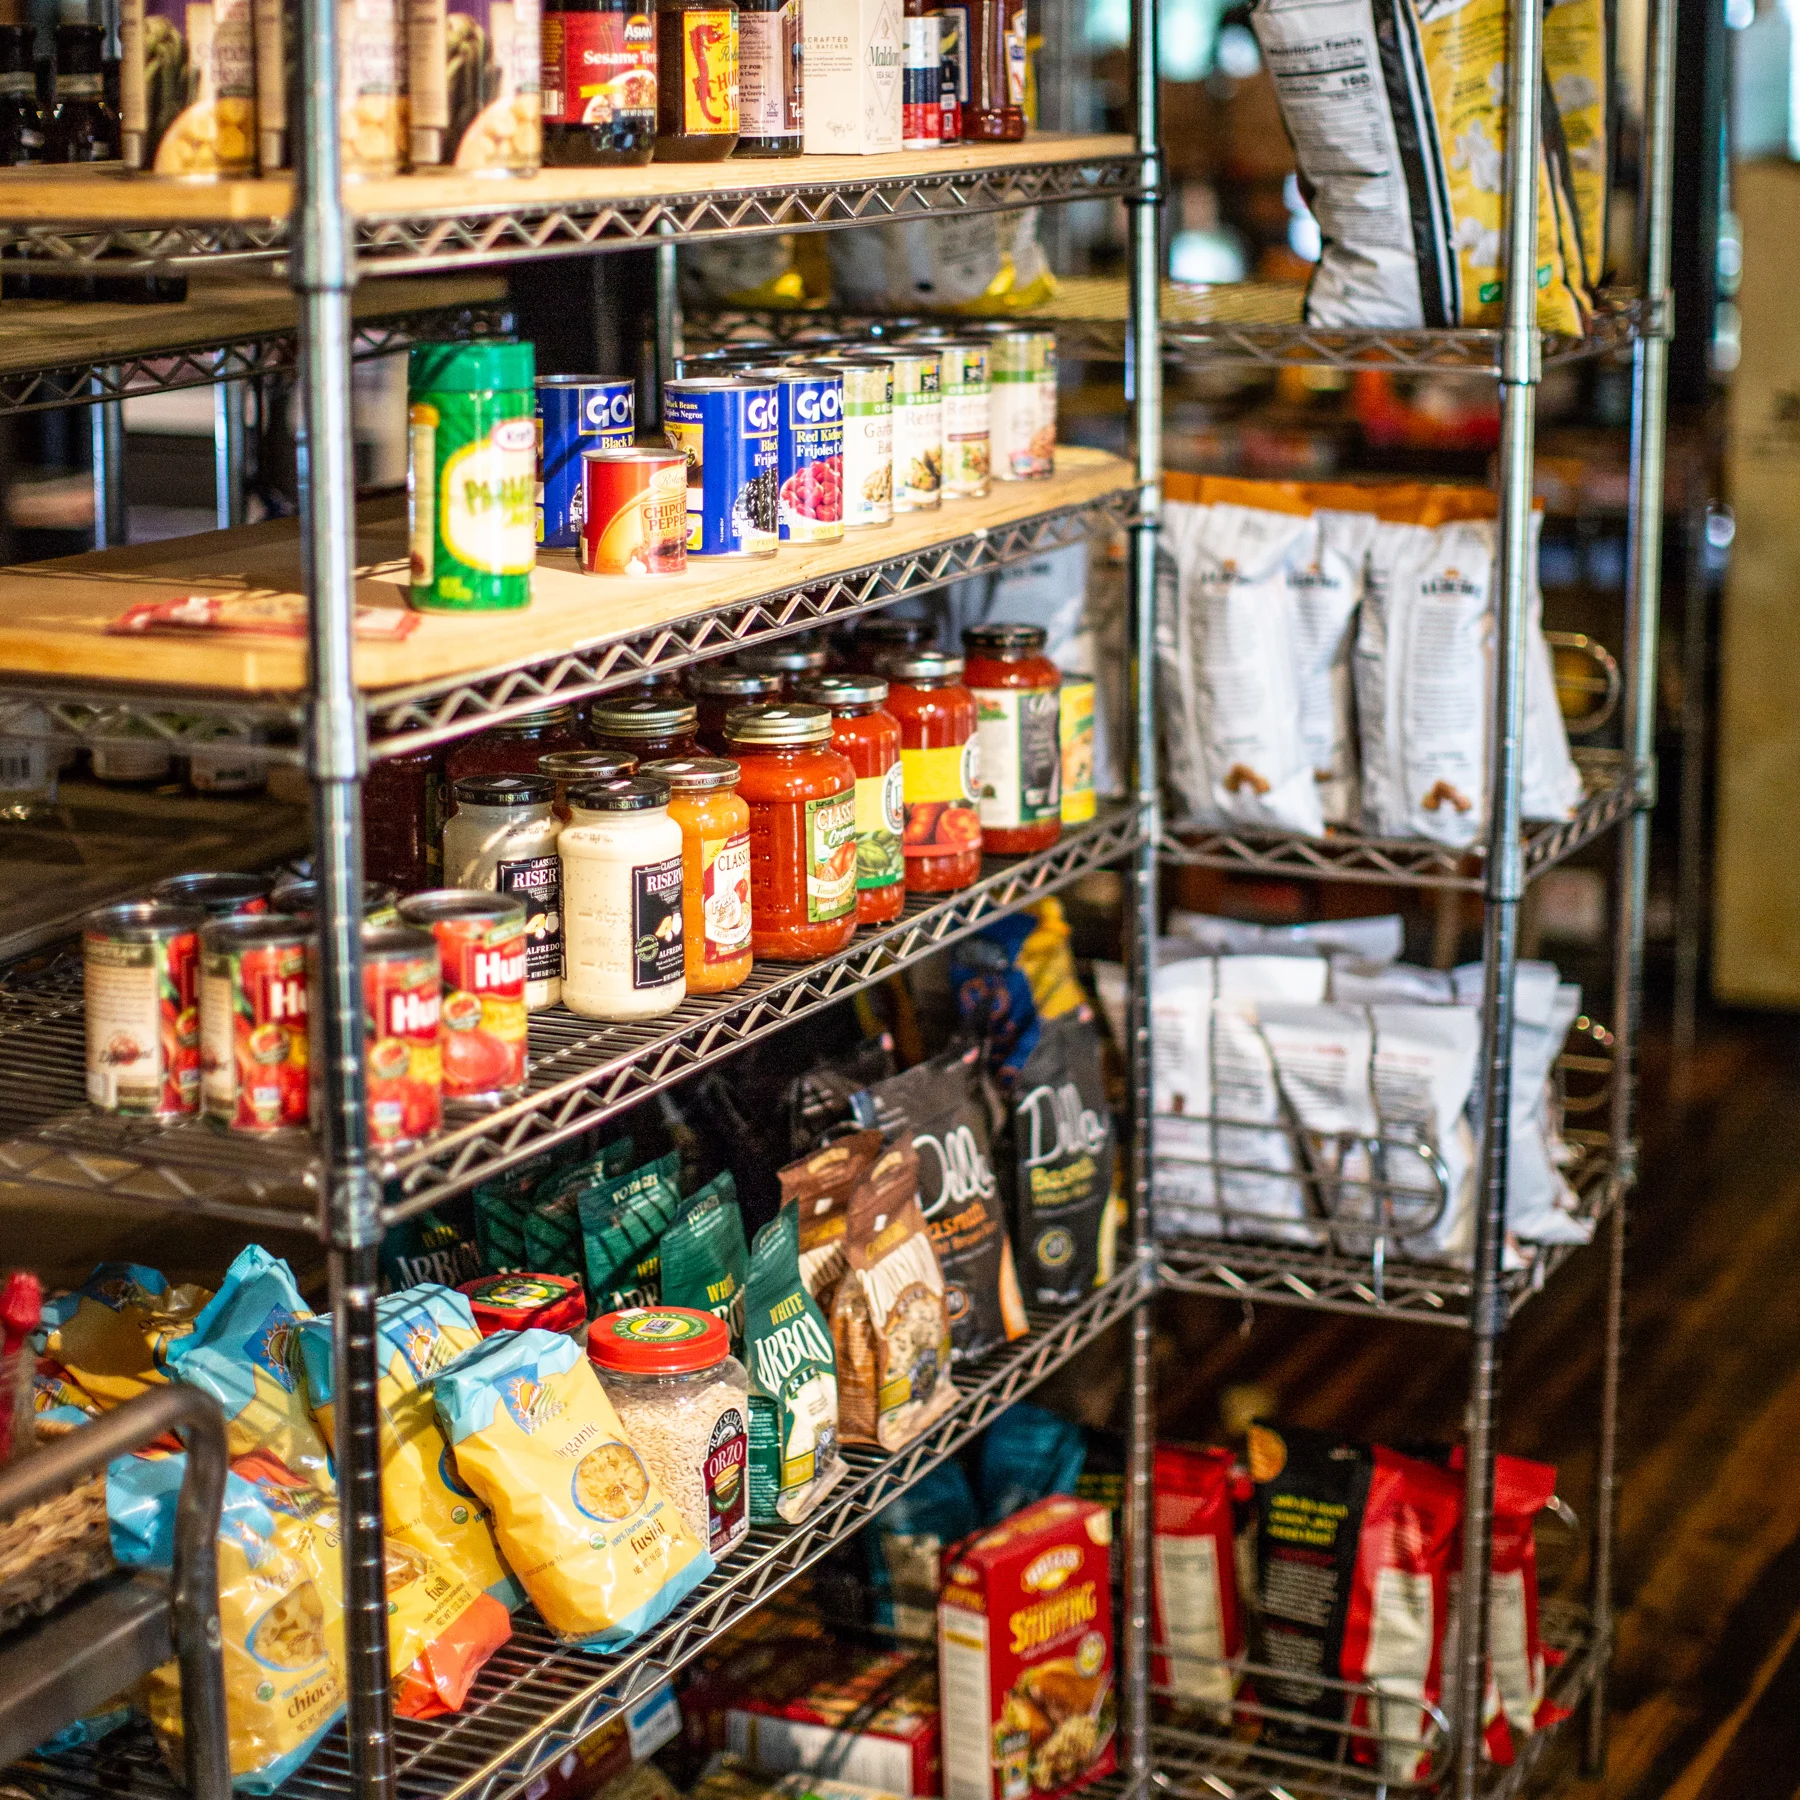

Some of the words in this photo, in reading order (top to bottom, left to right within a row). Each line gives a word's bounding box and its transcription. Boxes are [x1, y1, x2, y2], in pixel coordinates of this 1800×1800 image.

[583, 50, 638, 65] Sesame
[877, 71, 885, 79] SEA
[886, 71, 894, 79] SALT
[679, 401, 698, 410] Beans
[680, 410, 703, 419] Negros
[601, 436, 627, 449] Black
[796, 430, 818, 442] Red
[796, 444, 833, 460] Frijoles
[696, 778, 720, 786] CLASSICO
[499, 793, 531, 802] RISERVA
[608, 800, 640, 809] RISERVA
[525, 942, 560, 955] ALFREDO
[658, 943, 683, 960] ALFREDO
[769, 1291, 805, 1327] WHITE
[552, 1420, 600, 1460] Organic
[709, 1440, 744, 1479] ORZO
[625, 1518, 646, 1537] Durum
[630, 1517, 666, 1556] fusilli
[424, 1575, 452, 1602] fusilli
